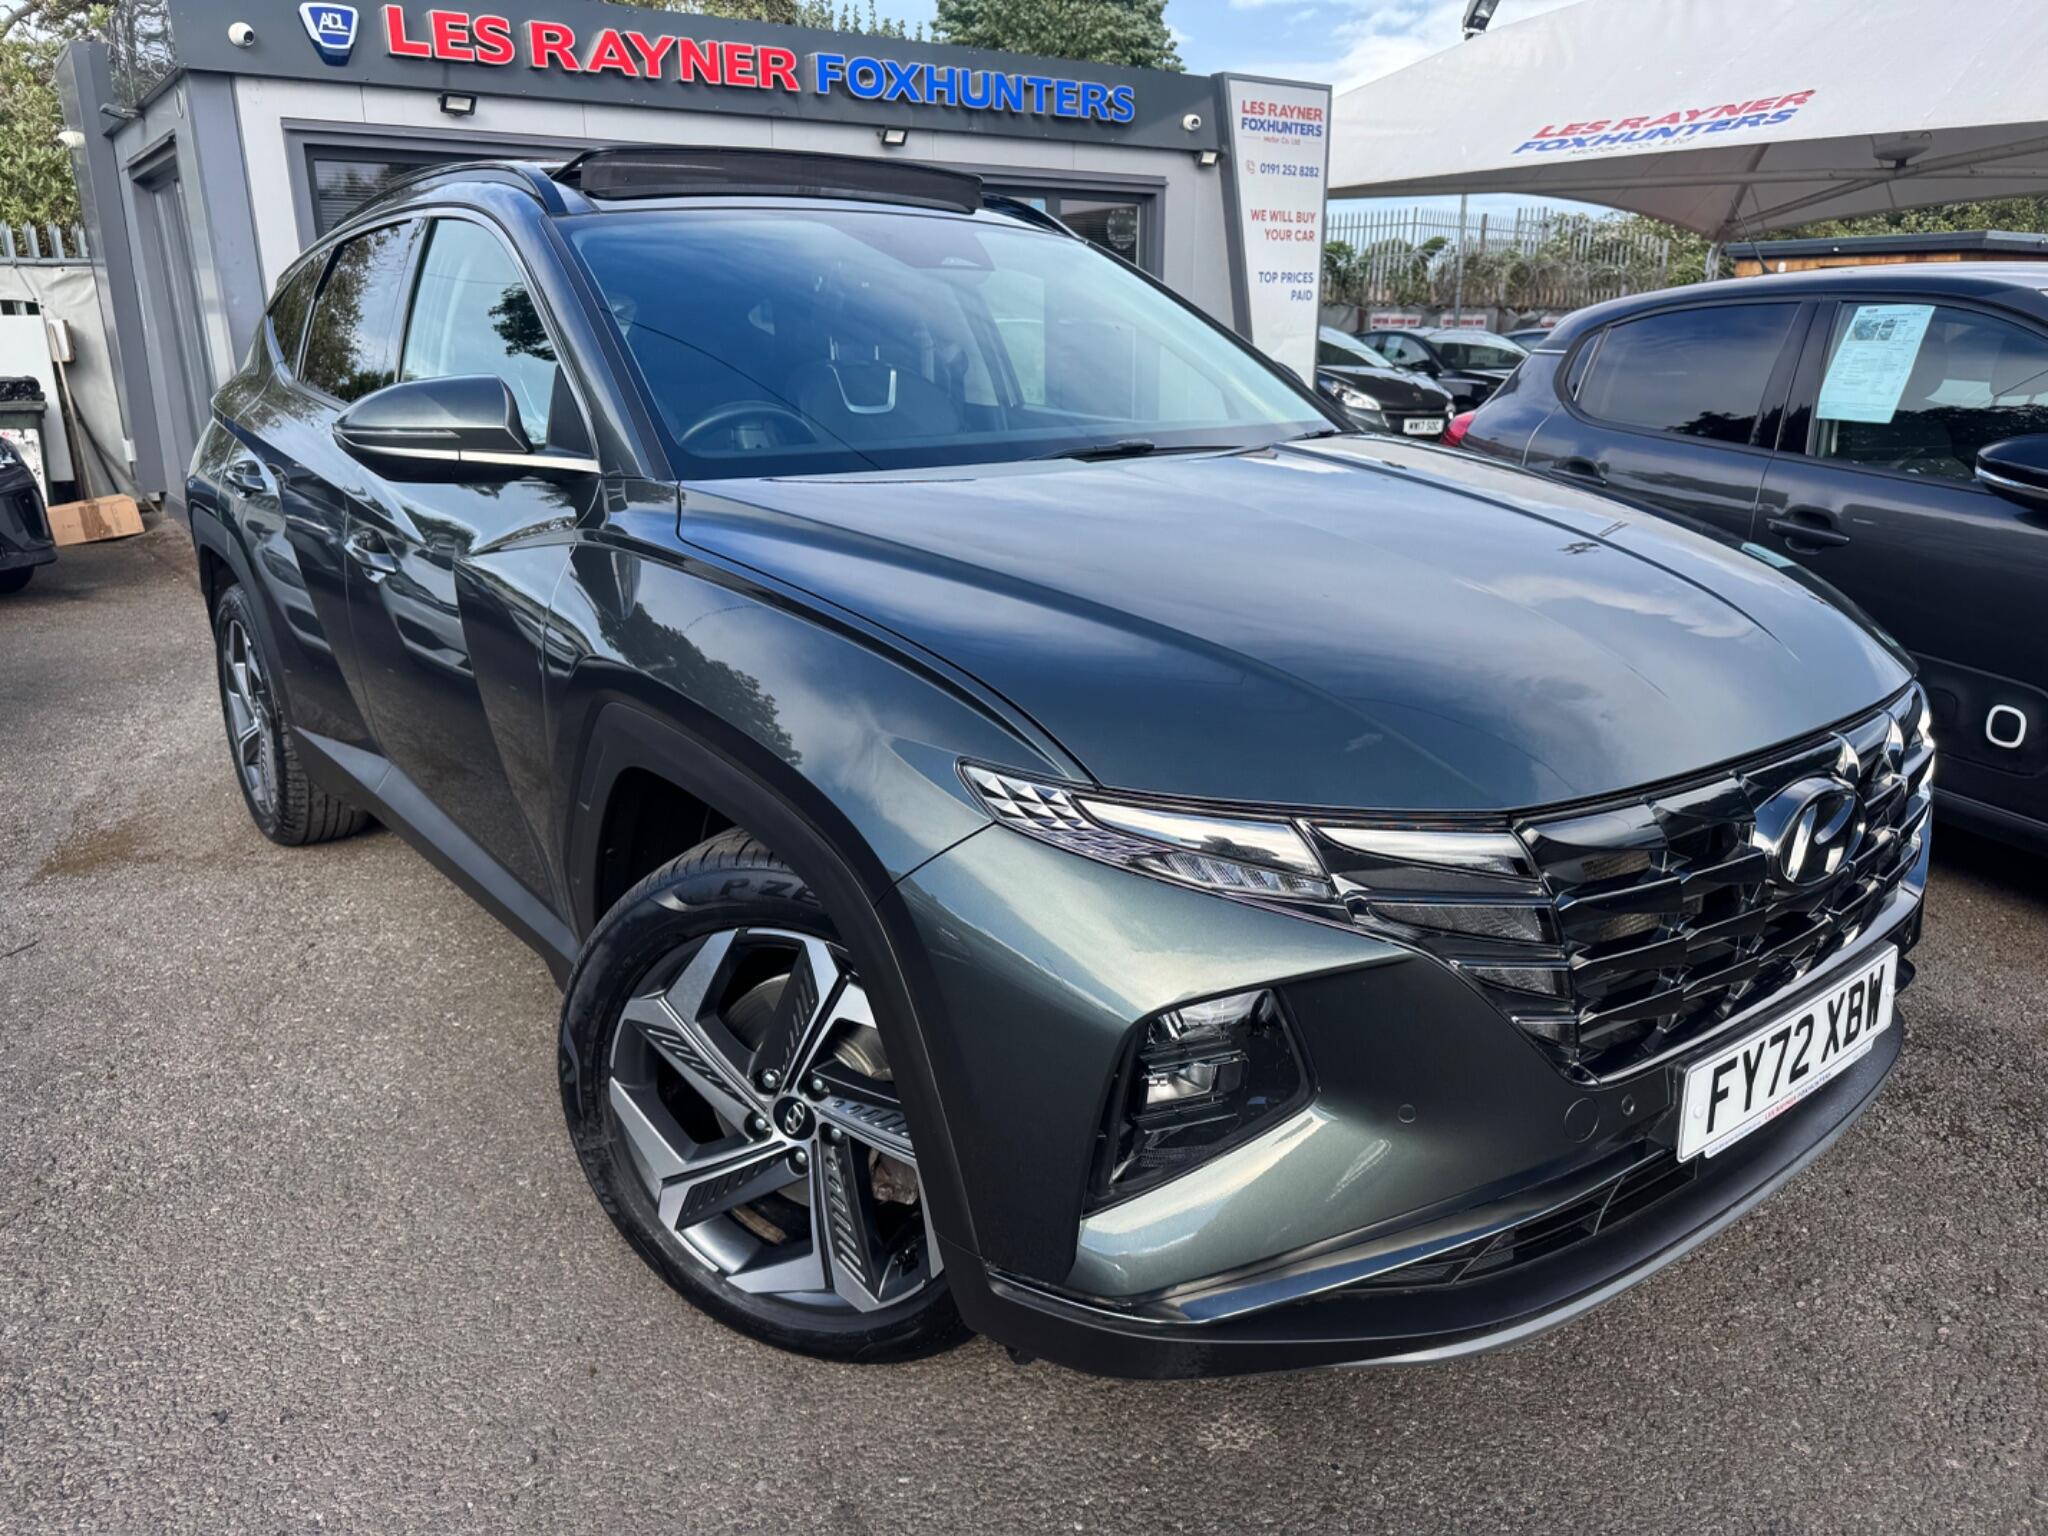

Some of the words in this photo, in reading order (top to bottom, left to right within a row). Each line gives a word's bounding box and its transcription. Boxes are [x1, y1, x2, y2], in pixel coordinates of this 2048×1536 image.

[384, 4, 516, 65] LES
[527, 20, 800, 91] RAYNER
[812, 52, 1136, 123] FOXHUNTERS
[1241, 100, 1266, 116] LES
[1268, 103, 1323, 122] RAYNER
[1533, 119, 1611, 139] LES
[1610, 89, 1816, 132] RAYNER
[1241, 118, 1323, 137] FOXHUNTERS
[1511, 108, 1799, 155] FOXHUNTERS
[1260, 162, 1280, 175] 0191
[1282, 163, 1297, 176] 252
[1299, 165, 1319, 178] 8282
[1250, 208, 1267, 222] WE
[1269, 210, 1294, 223] WILL
[1296, 211, 1316, 224] BUY
[1264, 228, 1293, 241] YOUR
[1294, 229, 1316, 242] CAR
[1258, 271, 1279, 284] TOP
[1280, 272, 1314, 284] PRICES
[1290, 289, 1313, 301] PAID
[720, 877, 751, 897] P
[1706, 1013, 1815, 1135] FY72
[1820, 963, 1886, 1064] XBW
